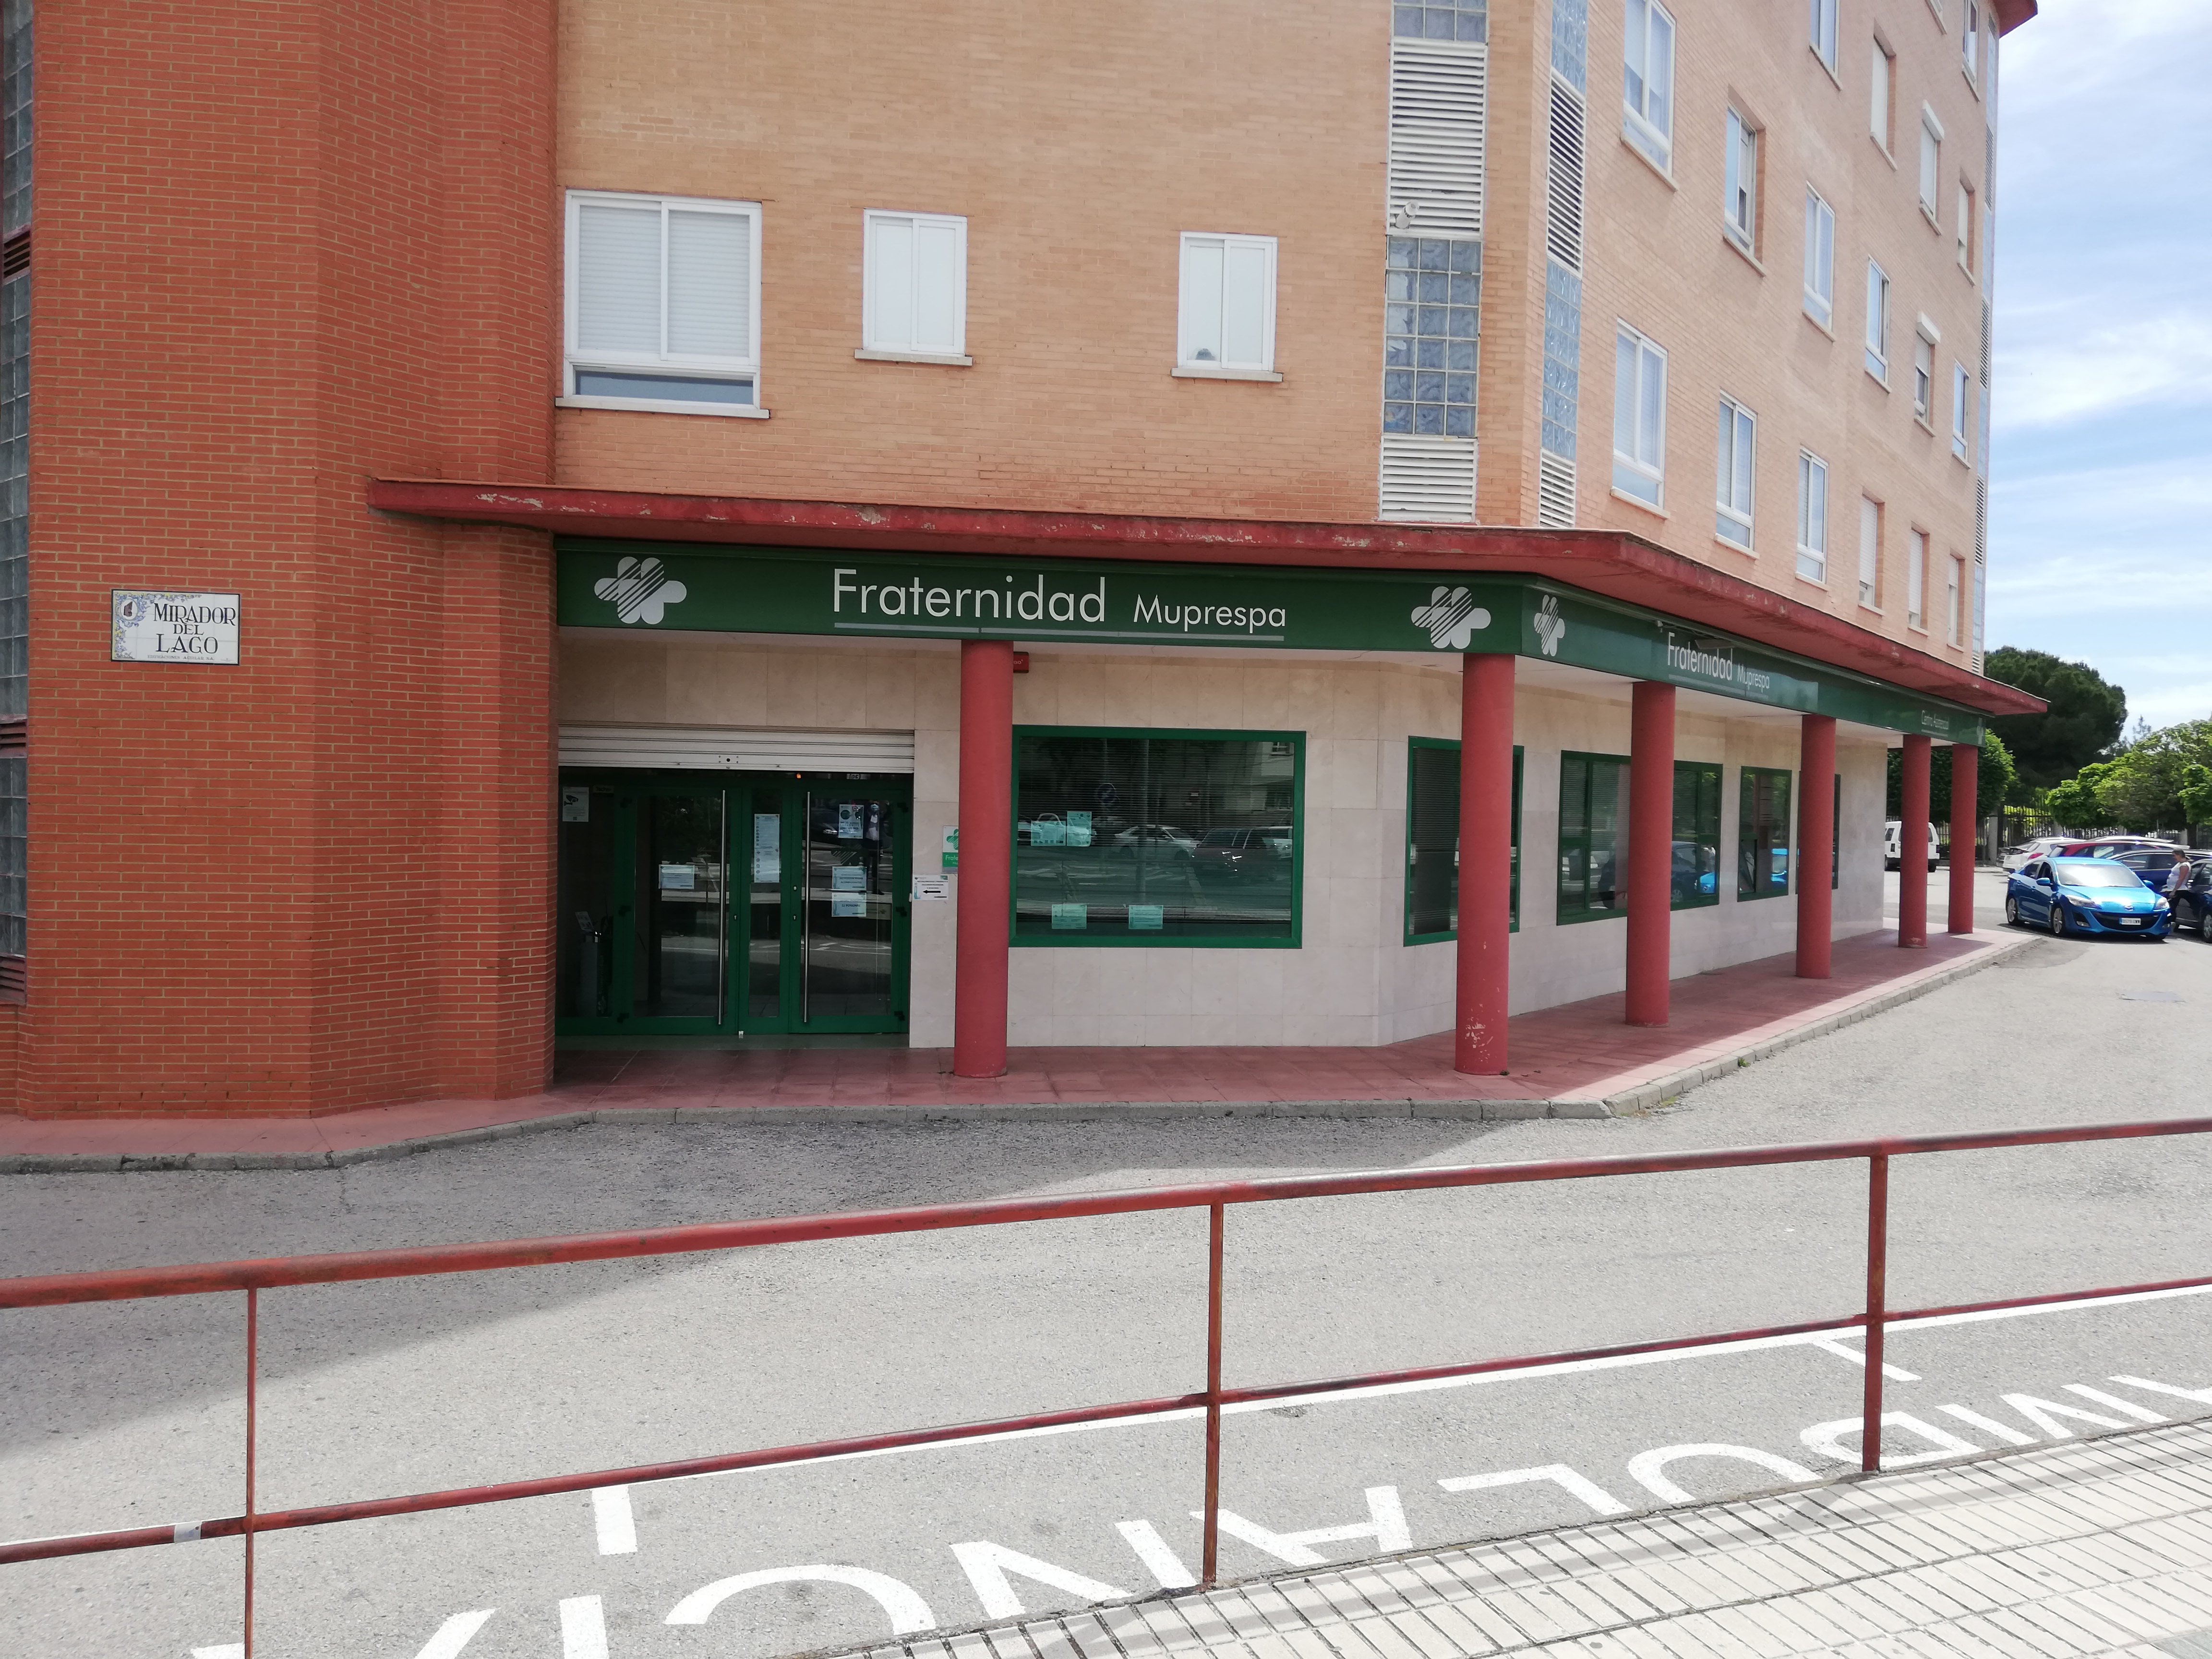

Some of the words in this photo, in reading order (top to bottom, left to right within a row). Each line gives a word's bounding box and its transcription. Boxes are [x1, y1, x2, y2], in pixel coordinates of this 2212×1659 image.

[834, 568, 1106, 623] Fraternidad
[1133, 594, 1286, 634] Muprespa
[154, 602, 236, 626] MIRADOR
[173, 624, 204, 635] DEL
[156, 633, 218, 654] LAGO
[1668, 632, 1733, 681] Fraternidad
[1737, 662, 1770, 693] Muprespa
